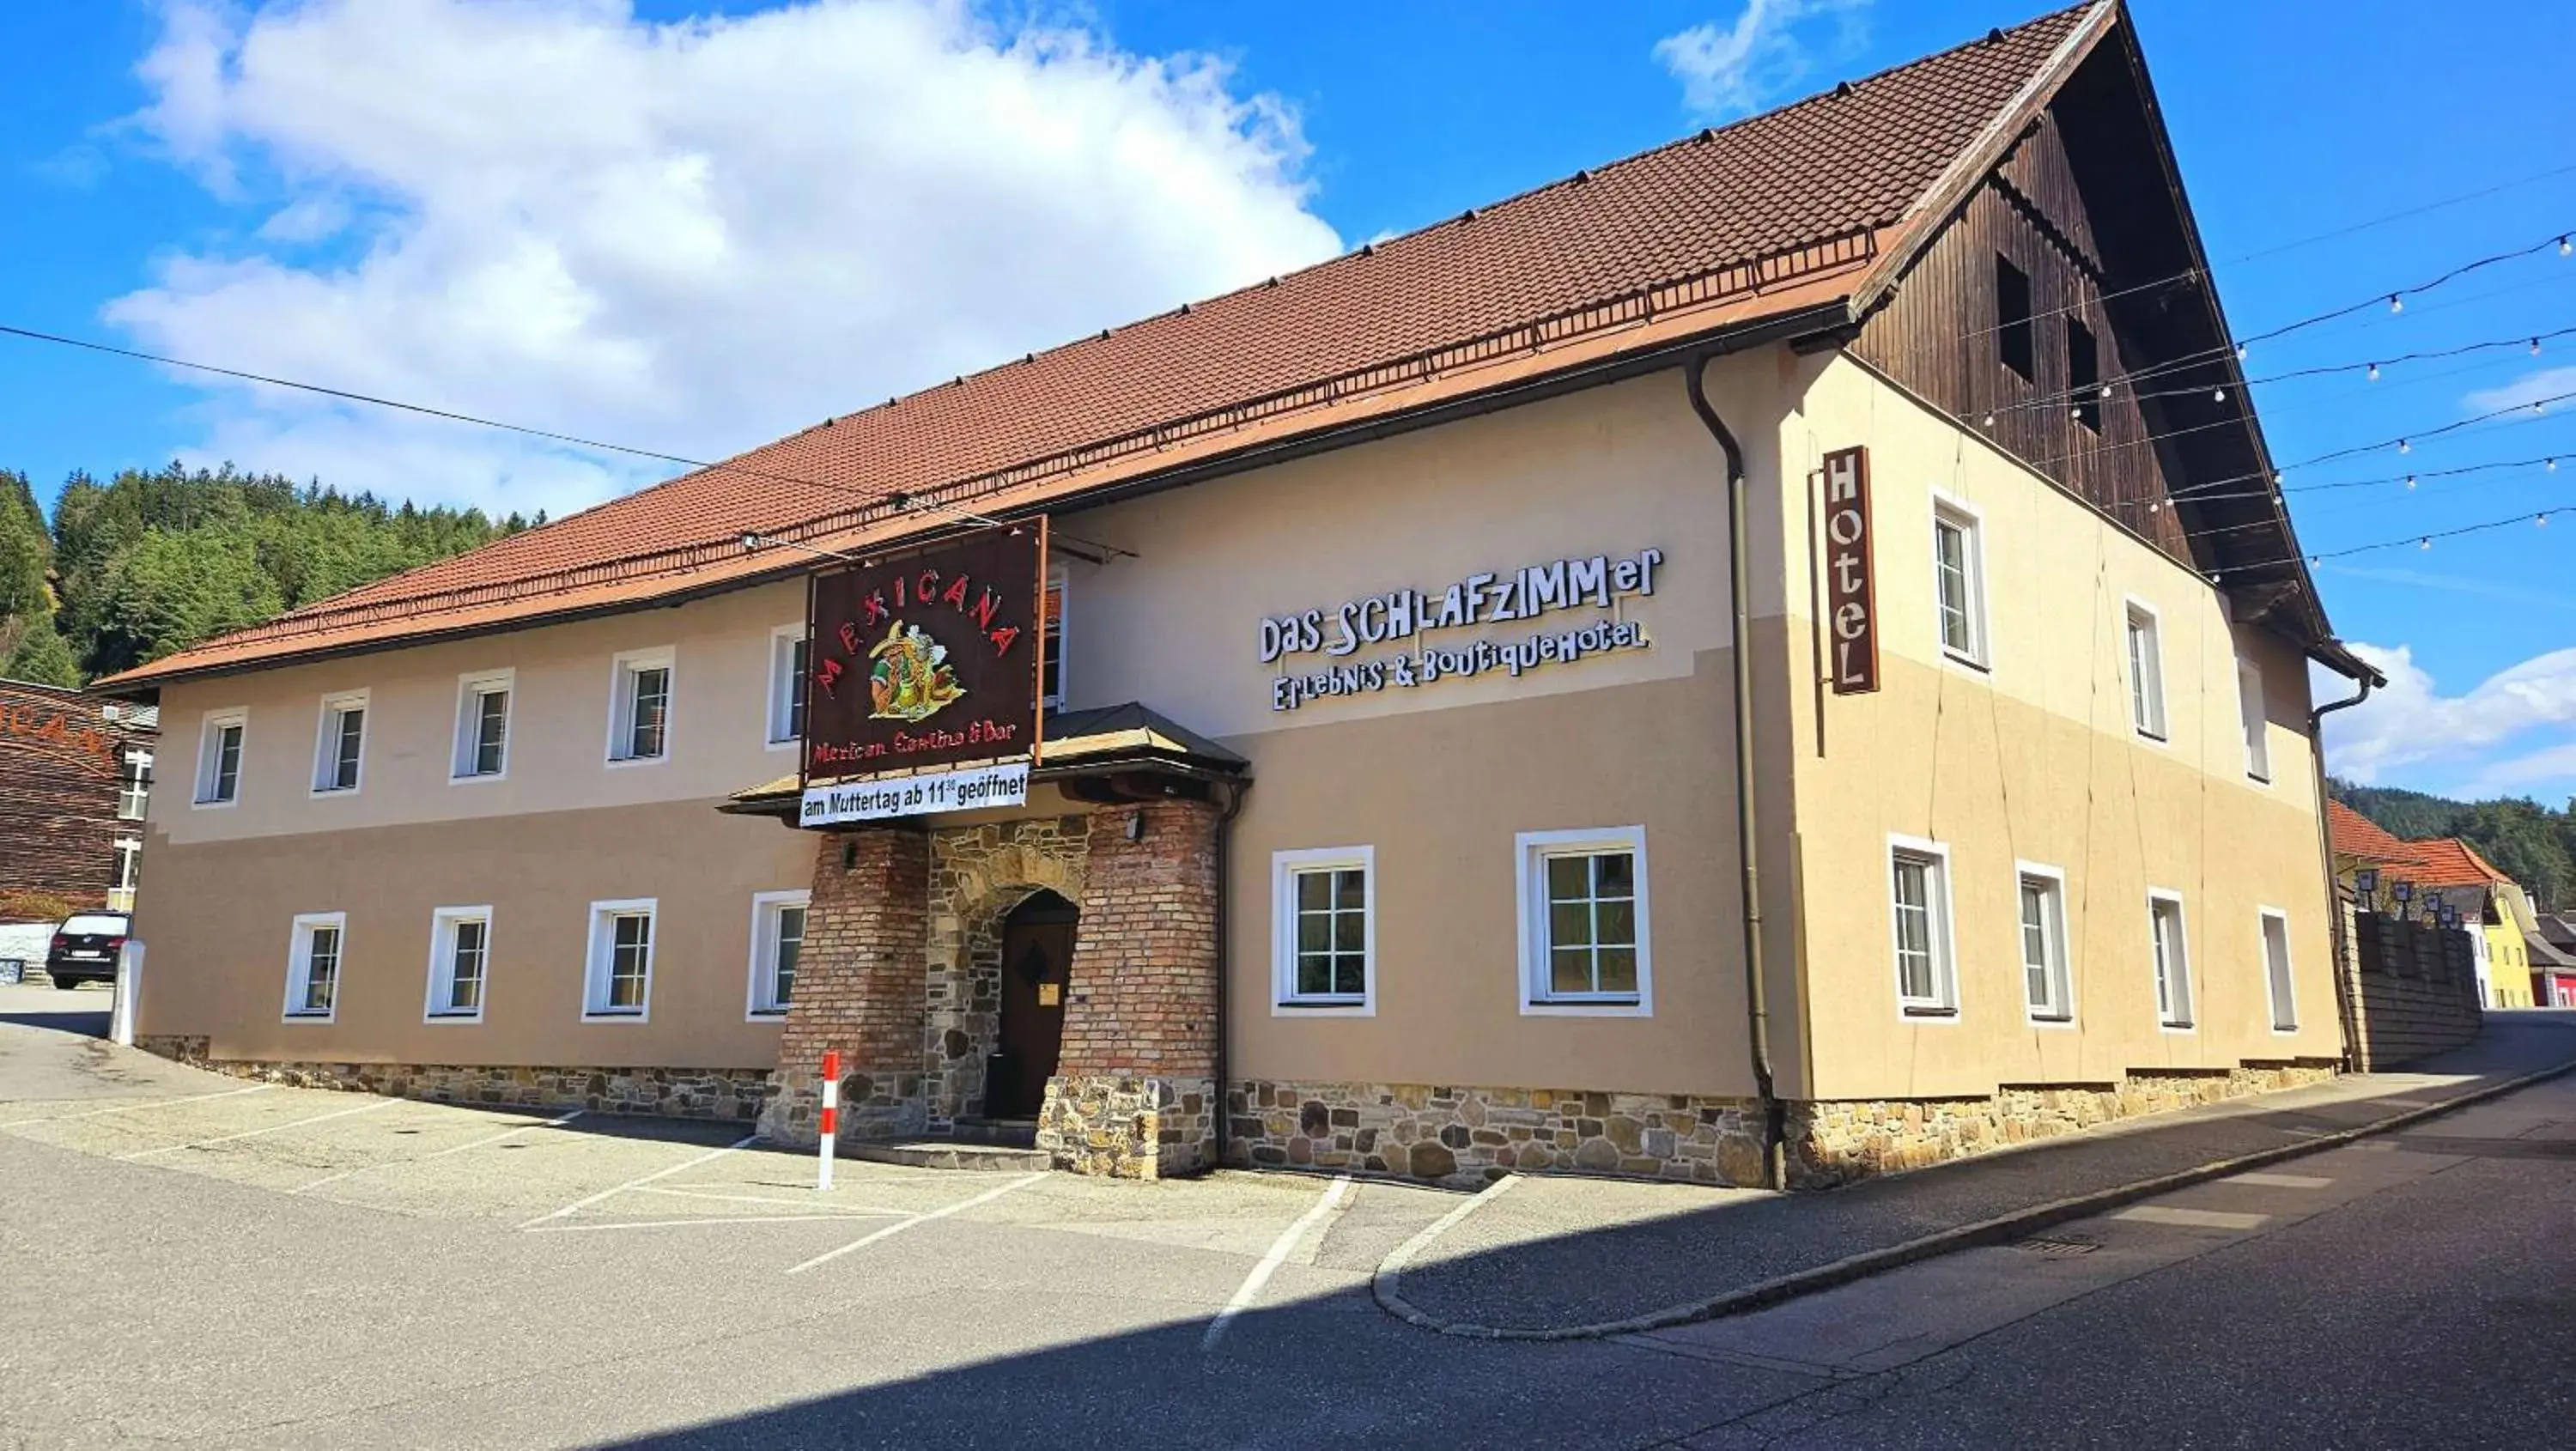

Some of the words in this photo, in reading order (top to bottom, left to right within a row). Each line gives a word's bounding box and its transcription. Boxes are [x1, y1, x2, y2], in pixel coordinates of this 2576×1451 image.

[816, 568, 1020, 700] MEXICANA
[1394, 653, 1419, 688] &
[811, 740, 889, 765] Mexican
[982, 719, 1017, 743] Bar
[805, 799, 825, 817] am
[829, 788, 900, 814] Muttertag
[904, 784, 923, 805] ab
[957, 773, 1025, 806] geöffnet
